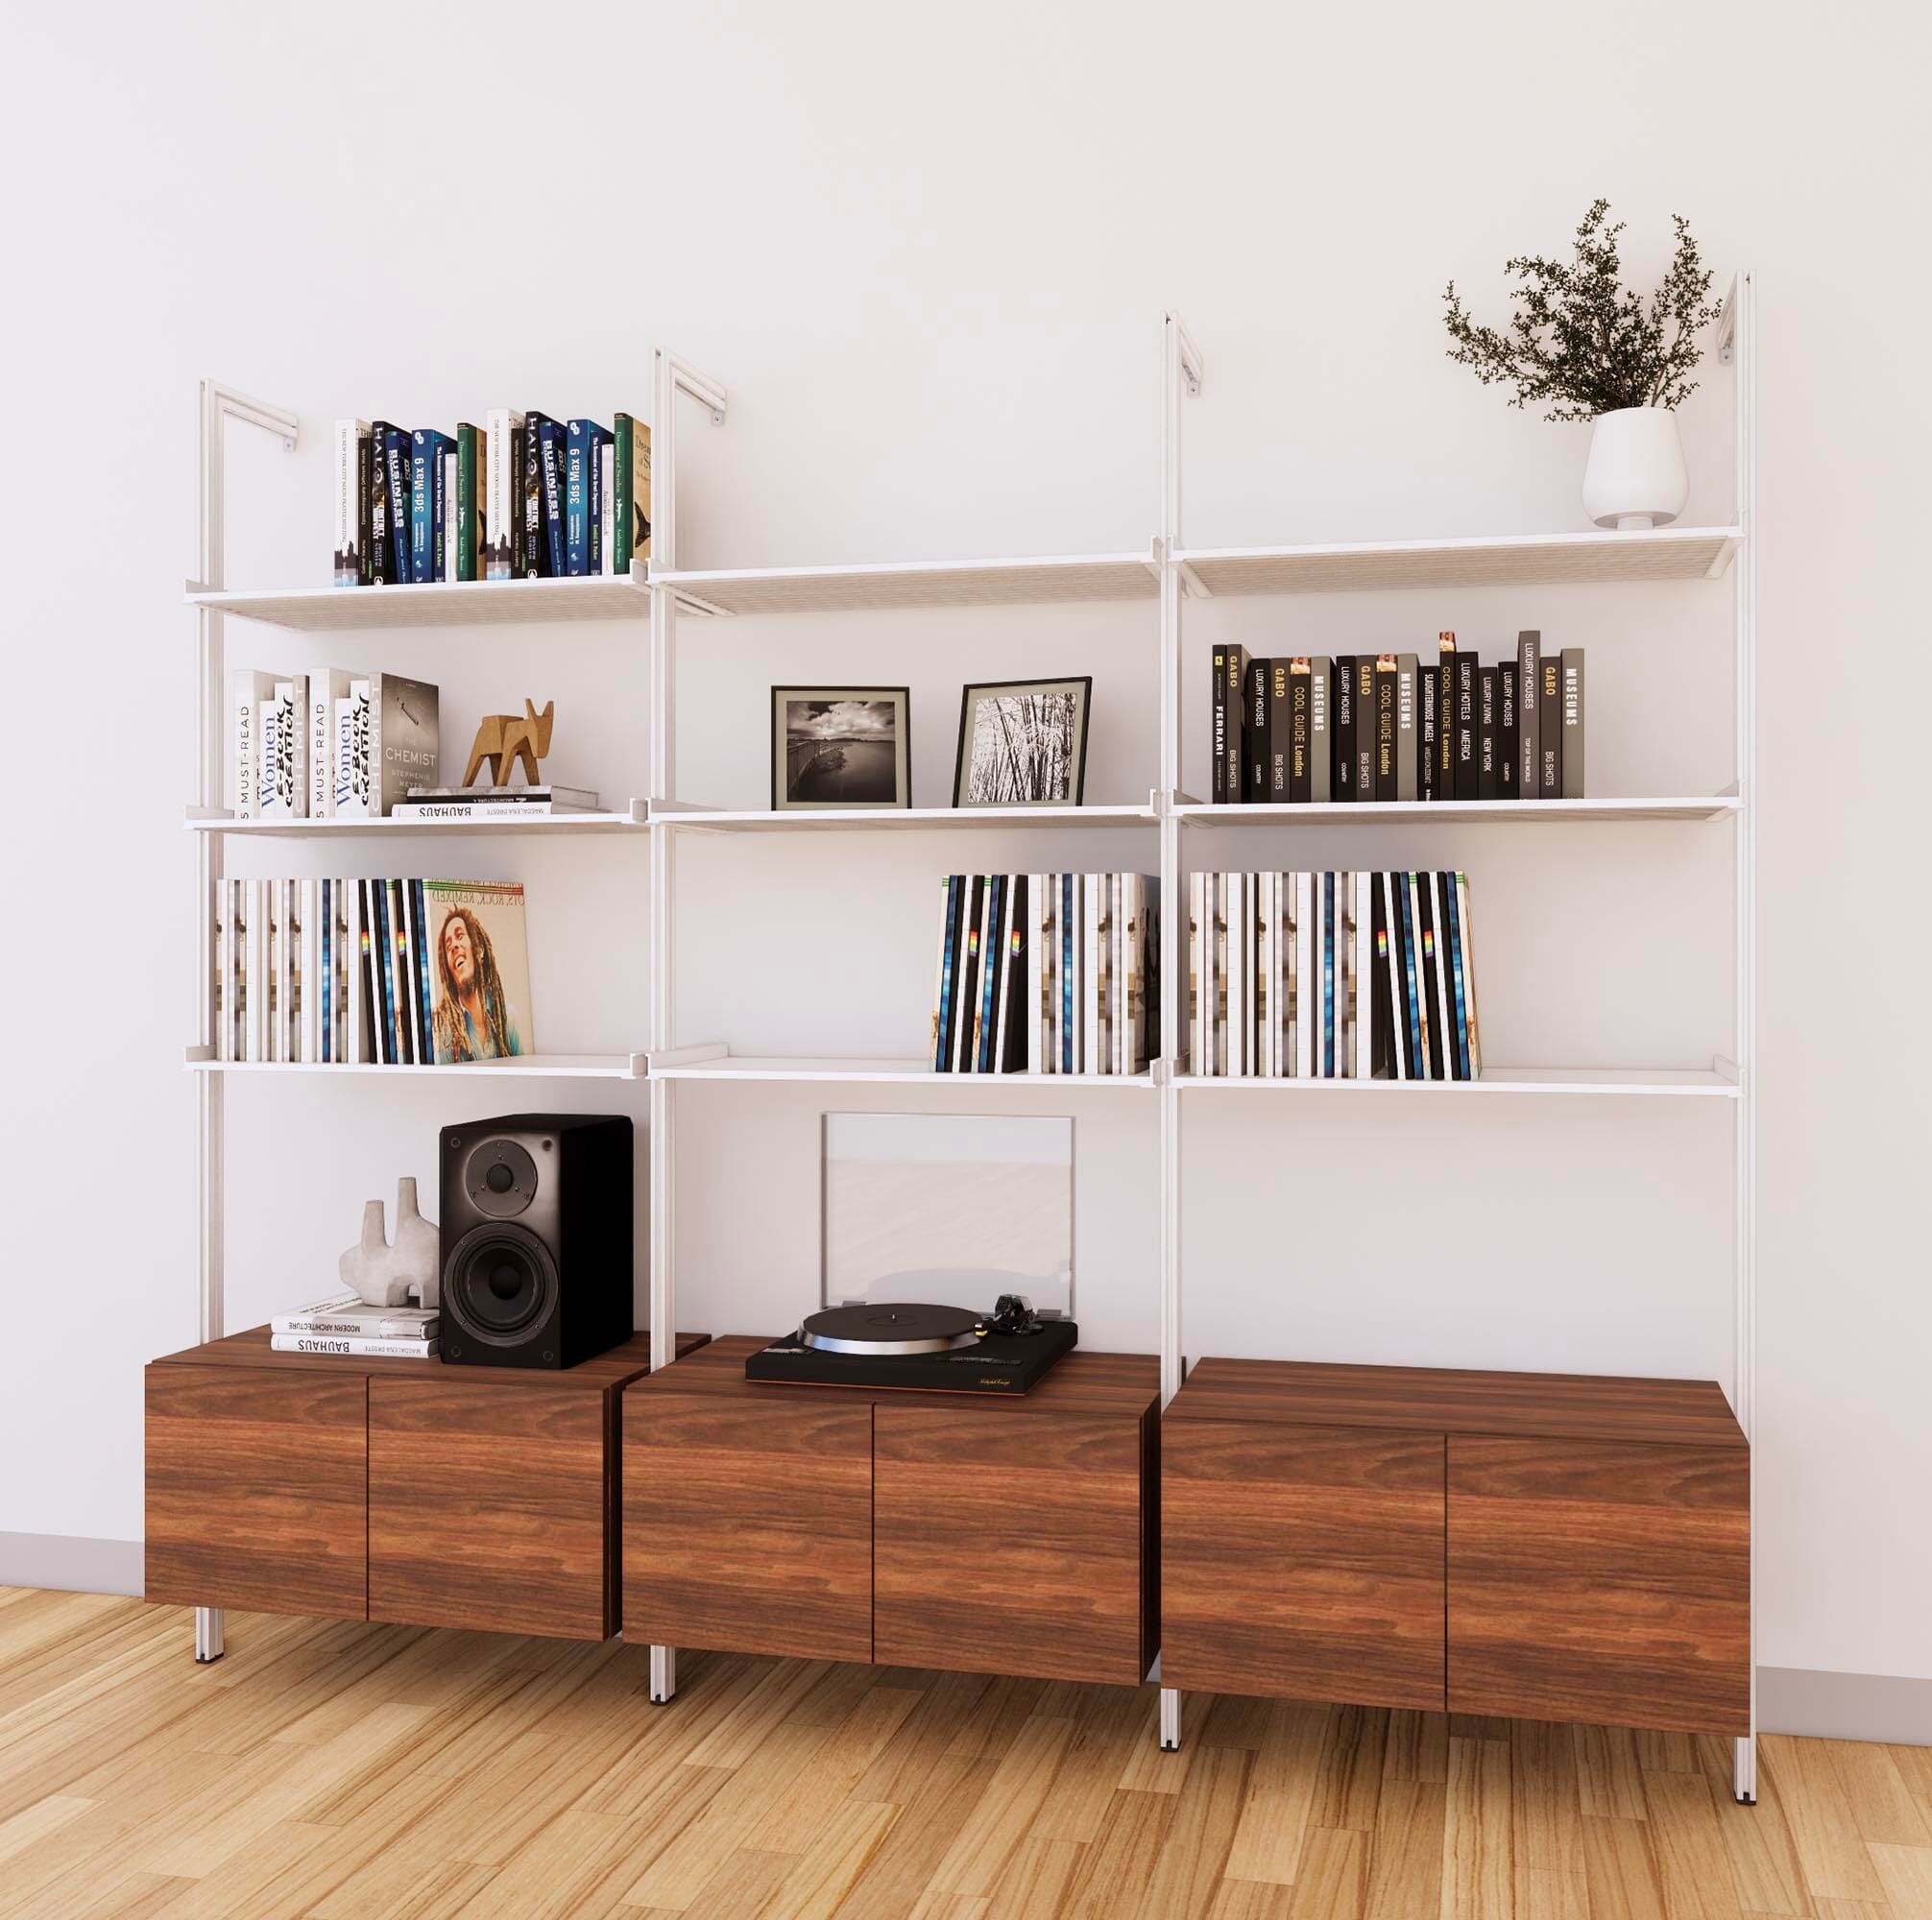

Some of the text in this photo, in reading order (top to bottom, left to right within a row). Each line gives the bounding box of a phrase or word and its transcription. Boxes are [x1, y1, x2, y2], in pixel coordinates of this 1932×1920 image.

[374, 427, 383, 484] HALO
[527, 418, 537, 475] HALO
[570, 459, 580, 481] Max
[391, 449, 404, 528] BUSINESS
[414, 468, 424, 490] Max
[414, 493, 424, 512] 3ds
[545, 440, 559, 520] BUSINESS
[570, 485, 580, 504] 3ds
[1315, 676, 1324, 731] MUSEUMS
[1362, 666, 1370, 695] GABO
[1401, 673, 1411, 729] MUSEUMS
[1461, 663, 1470, 720] LUXURY HOTELS
[1504, 672, 1512, 726] LUXURY HOUSES
[1525, 643, 1534, 708] LUXURY HOUSES
[1546, 667, 1556, 695] GABO
[1566, 669, 1577, 725] MUSEUMS
[1294, 687, 1305, 776] COOL GUIDE London
[1381, 685, 1390, 775] COOL GUIDE London
[1424, 674, 1434, 741] SLAUGHTERHOUSE ANGELS
[261, 716, 275, 807] Women
[277, 706, 285, 797] E-BOOK
[283, 695, 293, 807] CREATION
[337, 715, 350, 806] Women
[359, 692, 369, 805] CREATION
[386, 748, 436, 766] CHEMIST
[1461, 730, 1470, 760] AMERICA
[419, 806, 471, 816] BAUHAUS
[288, 1323, 332, 1332] ARCHITECTURE
[299, 1340, 350, 1352] BAUHAUS
